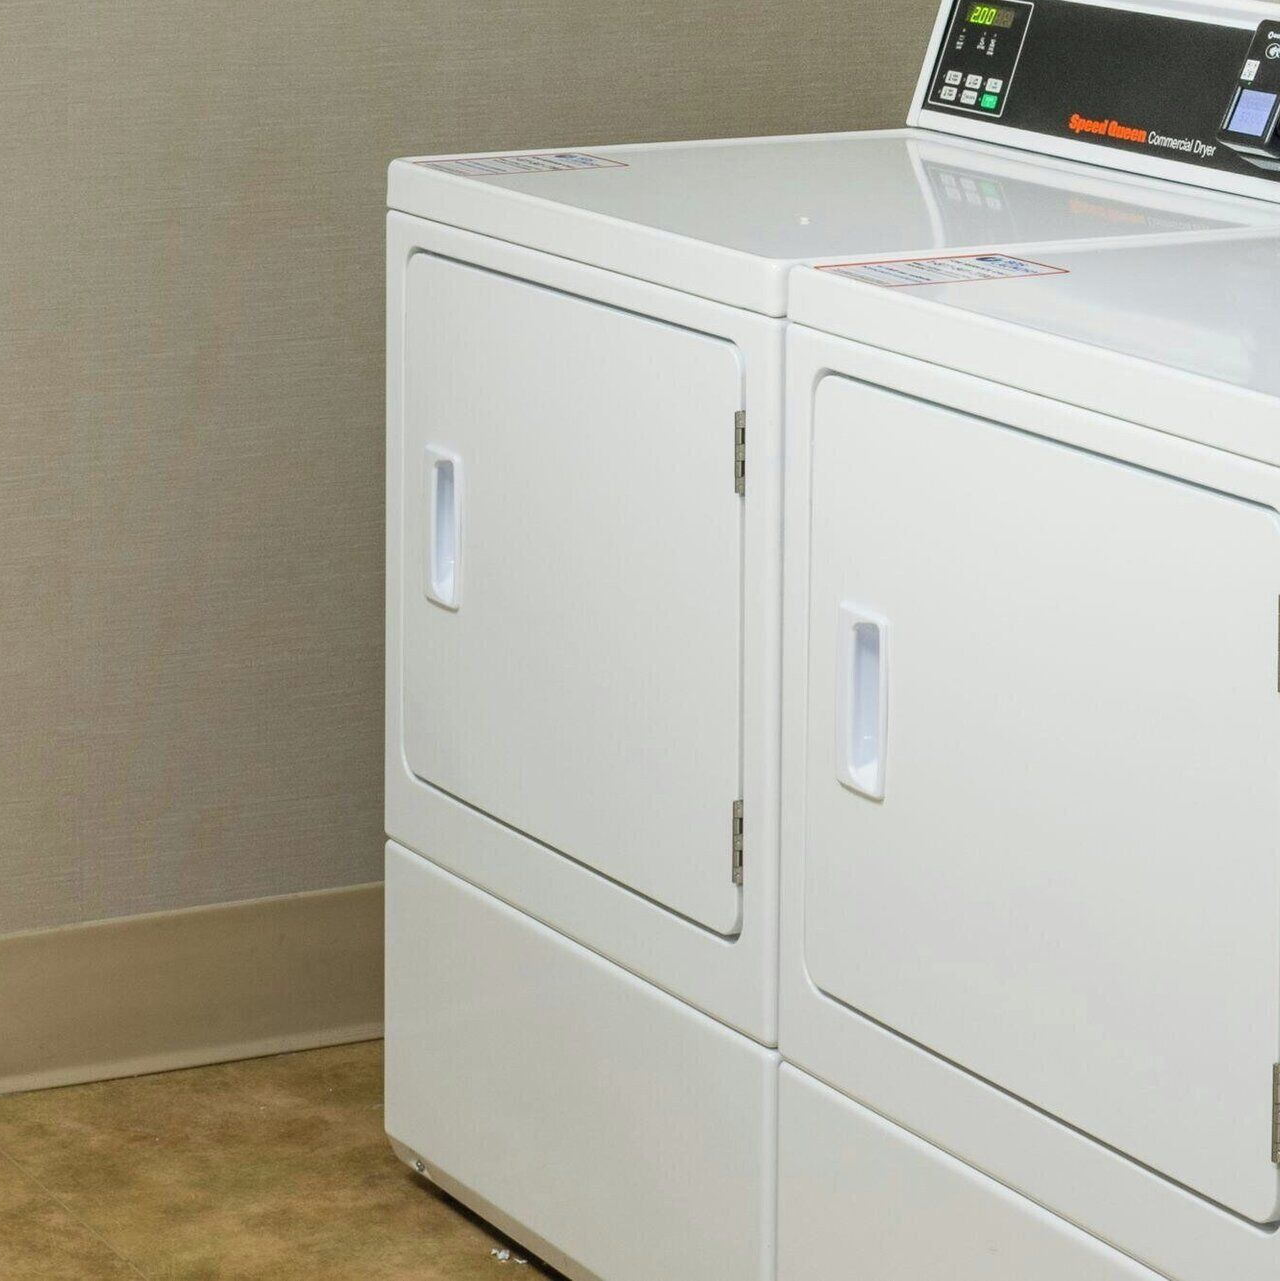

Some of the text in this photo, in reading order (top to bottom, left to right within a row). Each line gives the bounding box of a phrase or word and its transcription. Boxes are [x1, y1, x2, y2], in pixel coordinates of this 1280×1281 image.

[1068, 113, 1216, 158] Speed Queen Commercial Dryer
